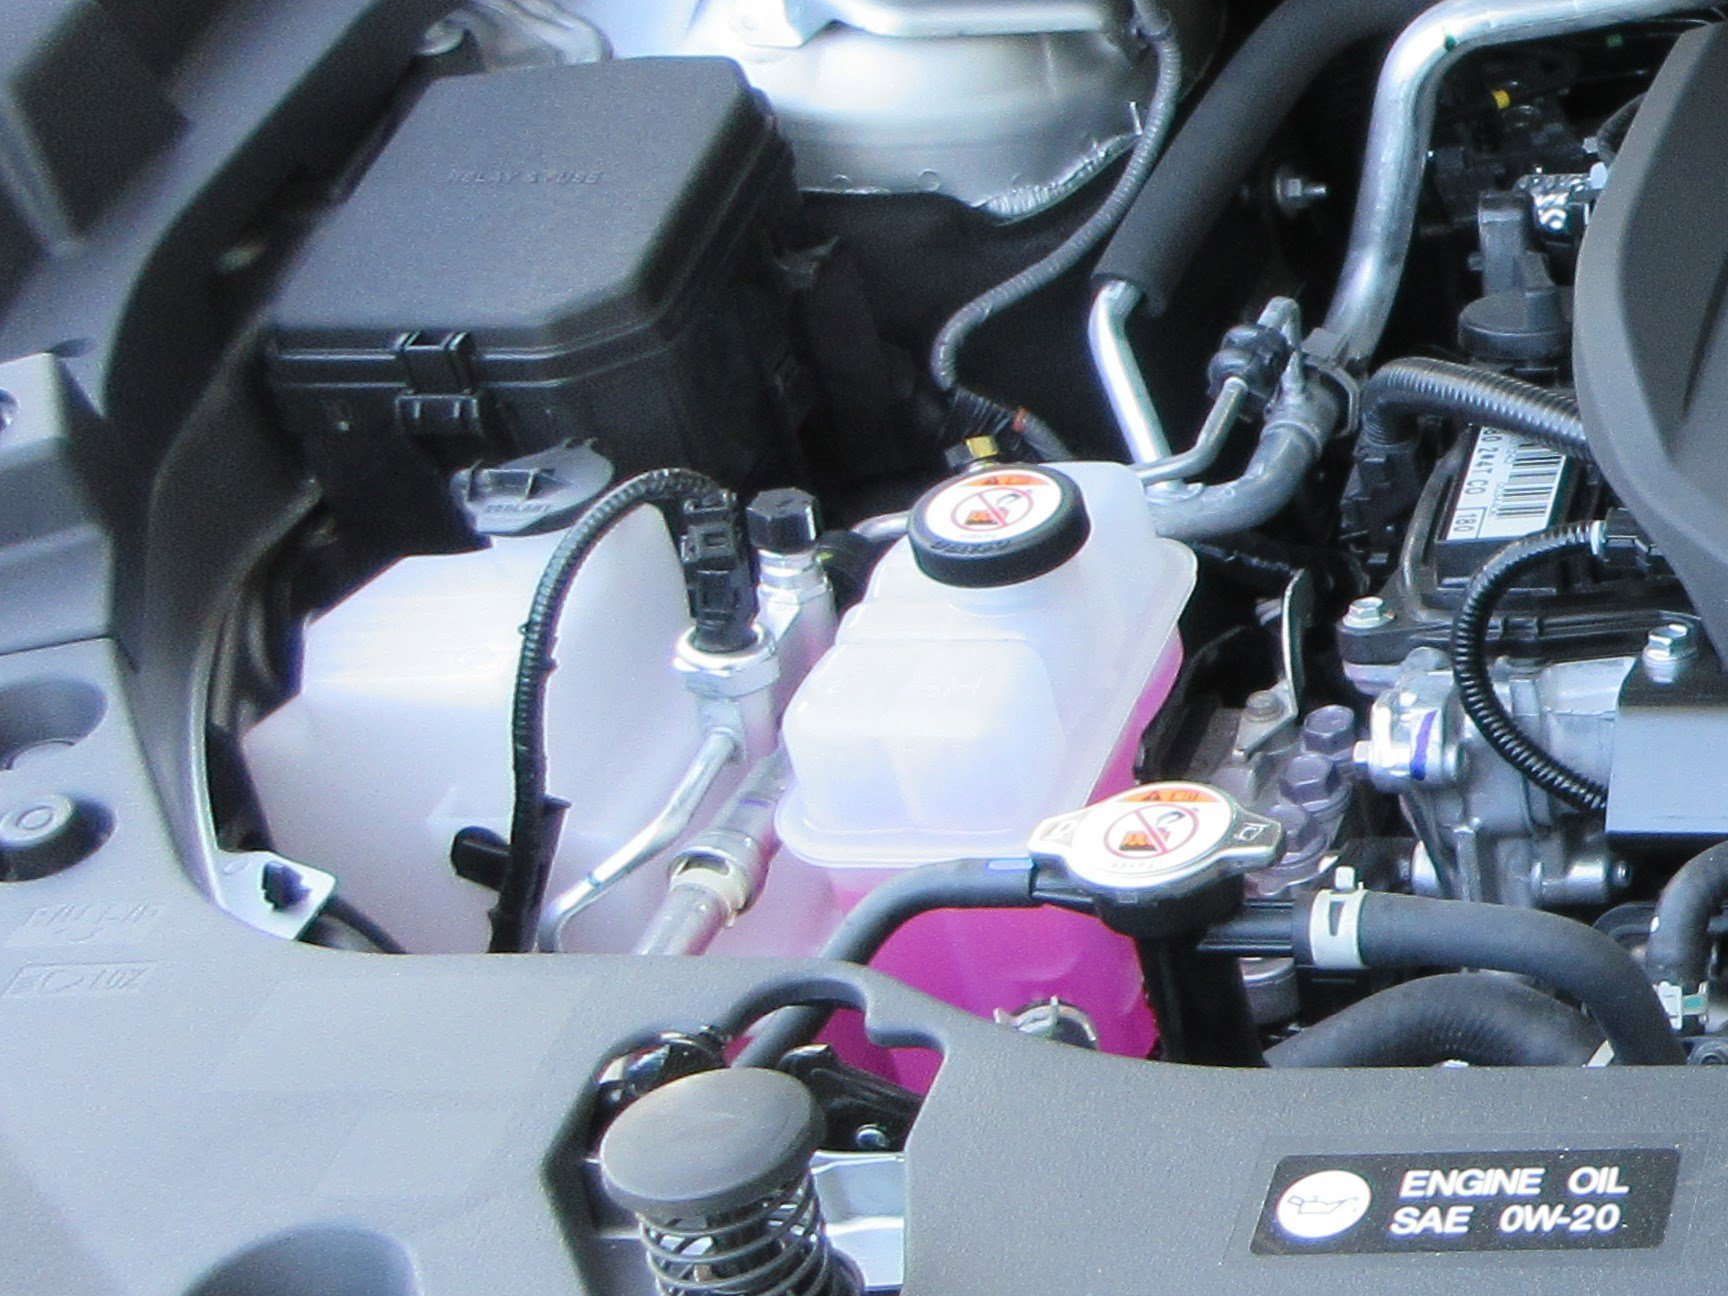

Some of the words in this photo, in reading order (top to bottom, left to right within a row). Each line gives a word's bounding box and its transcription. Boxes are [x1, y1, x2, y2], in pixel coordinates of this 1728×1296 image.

[1400, 1167, 1545, 1198] ENGINE
[1568, 1166, 1630, 1195] OIL
[1389, 1205, 1474, 1234] SAE
[1499, 1203, 1622, 1234] 0W-20
